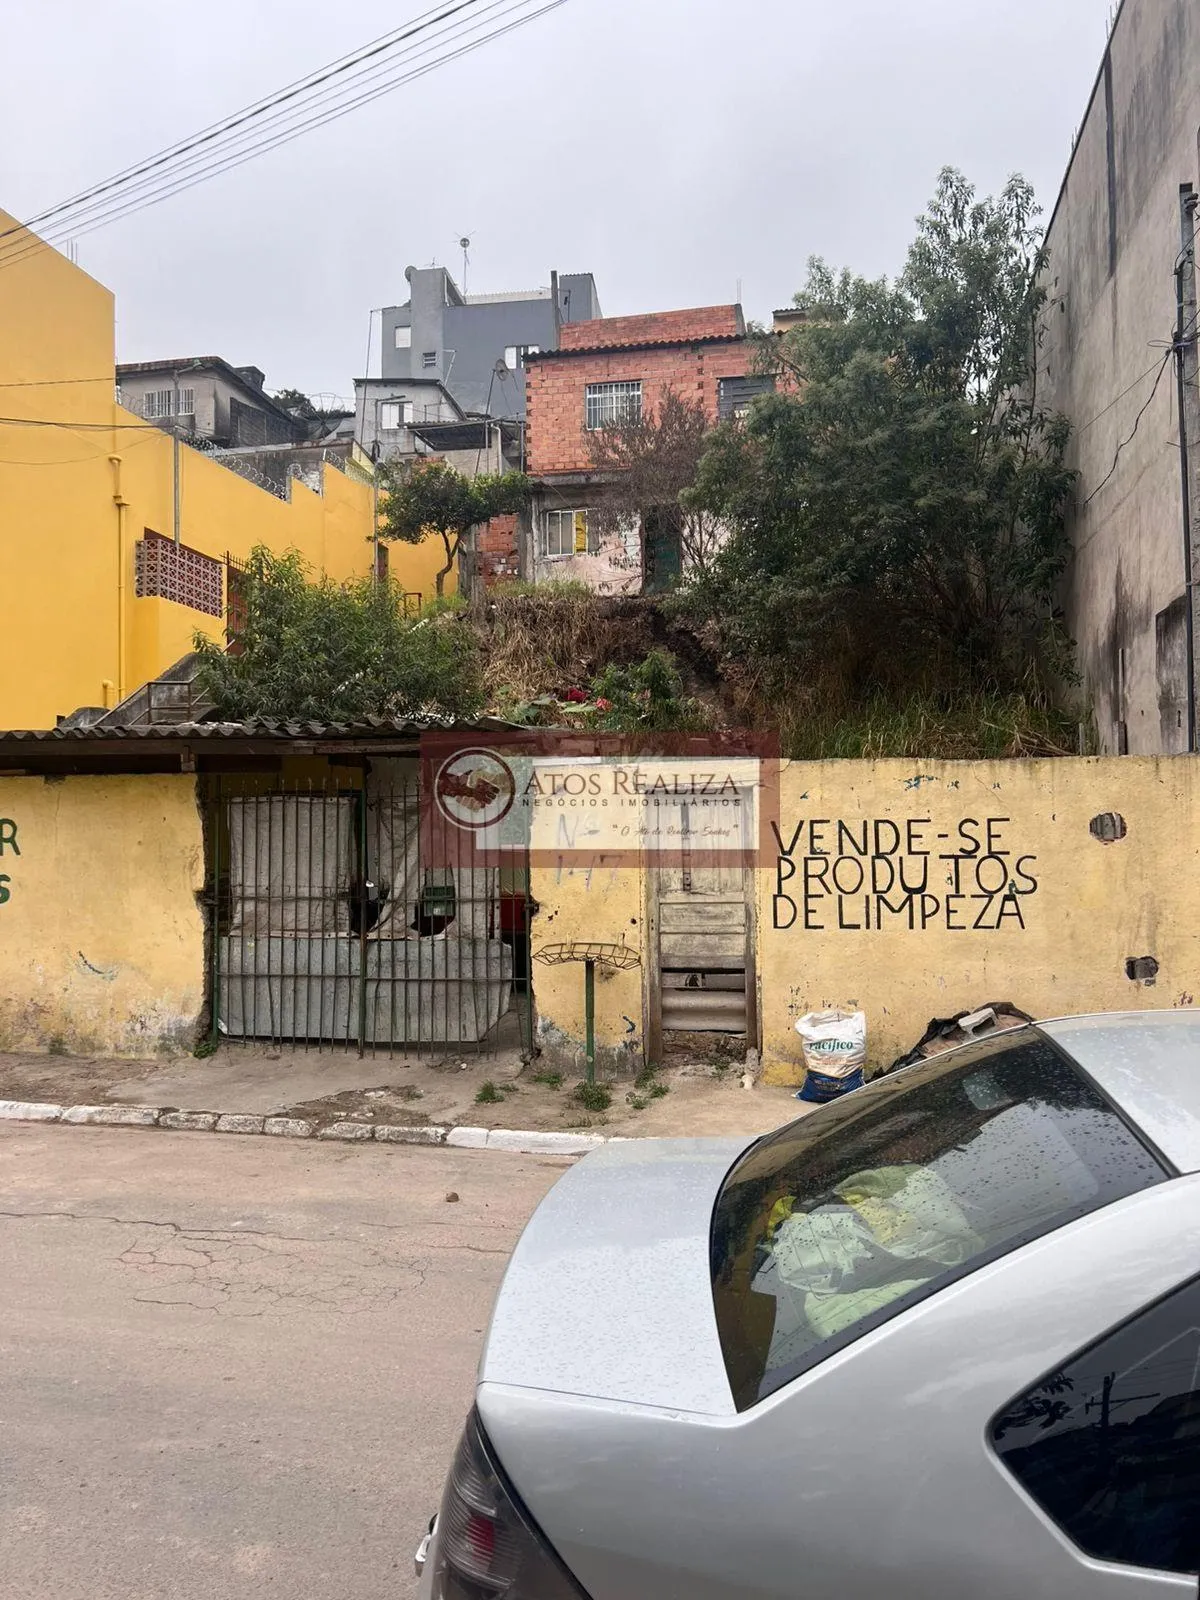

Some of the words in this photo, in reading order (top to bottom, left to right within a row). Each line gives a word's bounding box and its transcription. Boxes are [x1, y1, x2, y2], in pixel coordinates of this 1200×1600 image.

[770, 817, 1011, 856] VENDE-SE
[777, 854, 1038, 895] PRODUTOS
[773, 894, 824, 930] DE
[838, 894, 1026, 930] LIMPEZA
